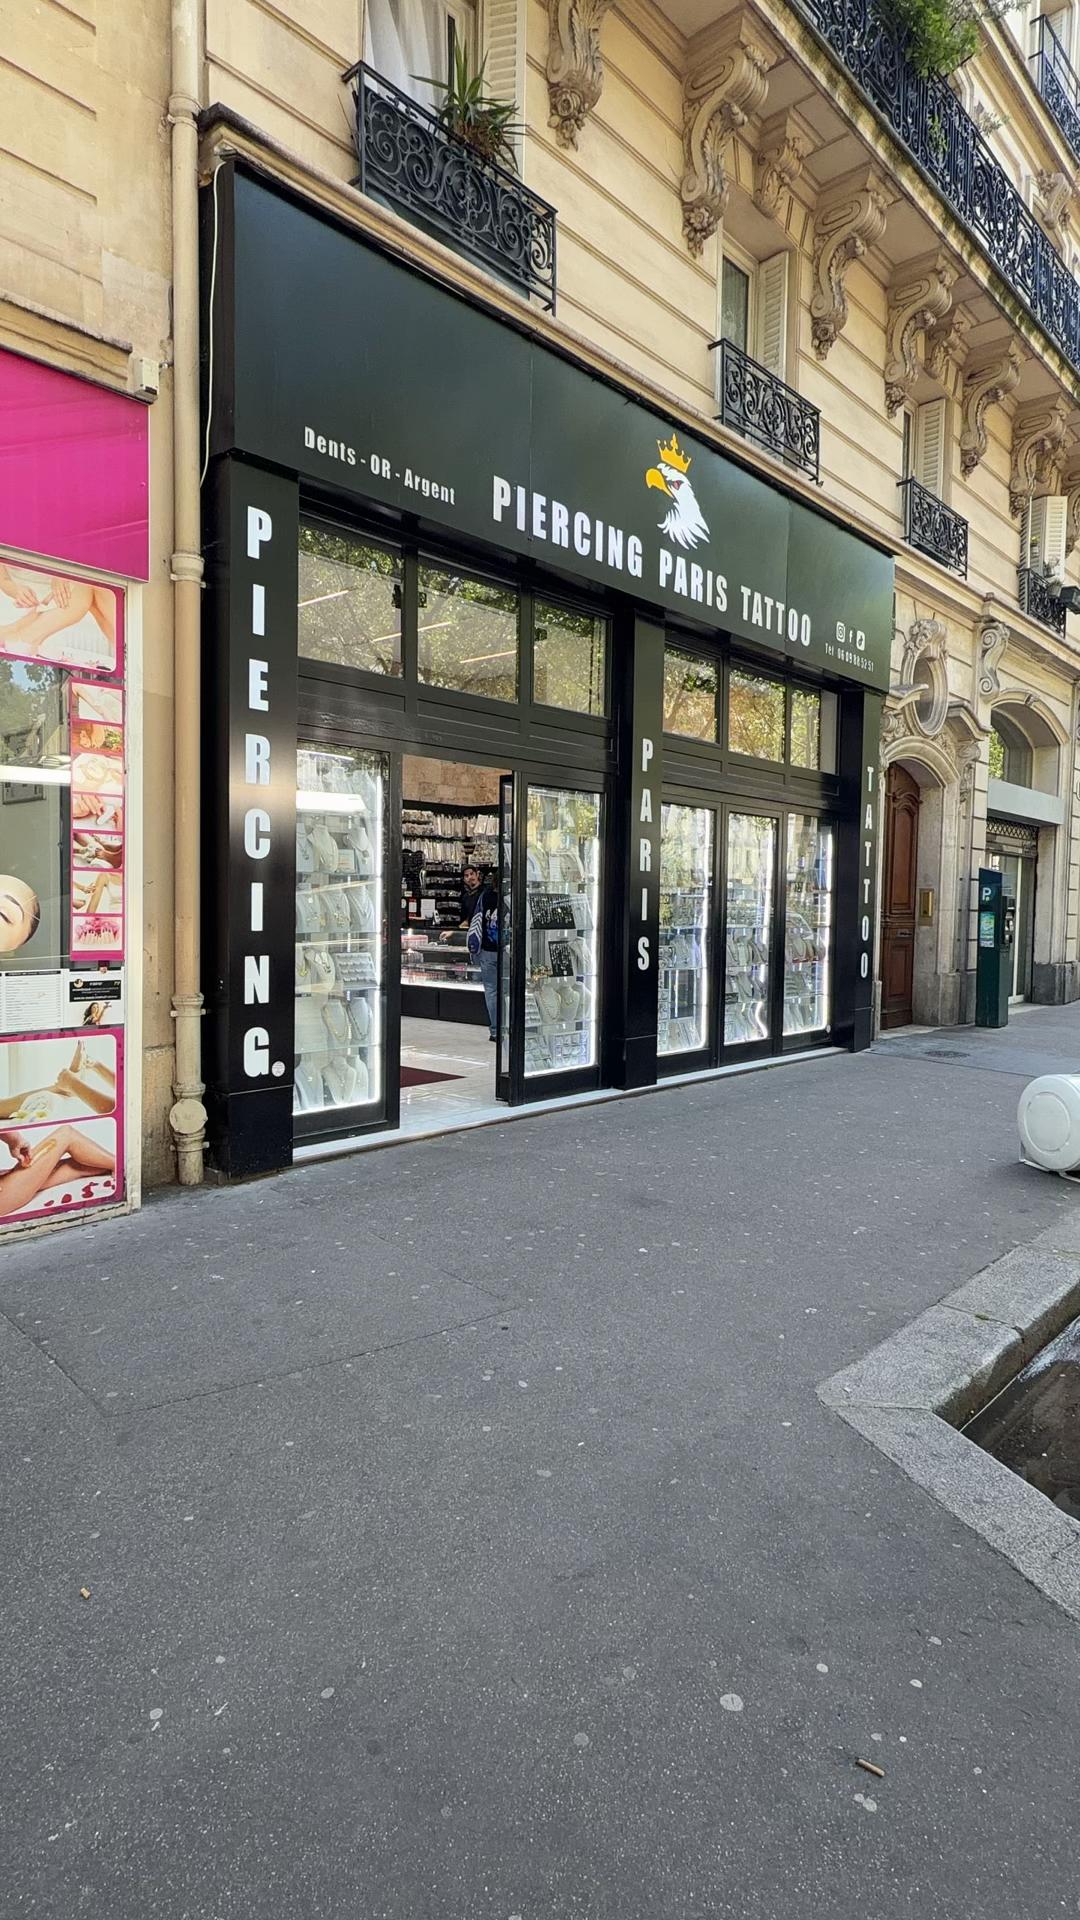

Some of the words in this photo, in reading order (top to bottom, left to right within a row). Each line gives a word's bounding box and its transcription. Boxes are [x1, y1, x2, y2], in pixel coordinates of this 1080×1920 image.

[304, 426, 356, 466] Dents
[370, 454, 391, 480] OR
[404, 468, 455, 505] Argent
[493, 475, 643, 578] PIERCING
[659, 548, 728, 612] PARIS
[741, 585, 811, 647] TATTOO
[244, 506, 273, 1077] PIERCING
[637, 738, 653, 970] PARIS
[860, 766, 874, 978] TATTOO
